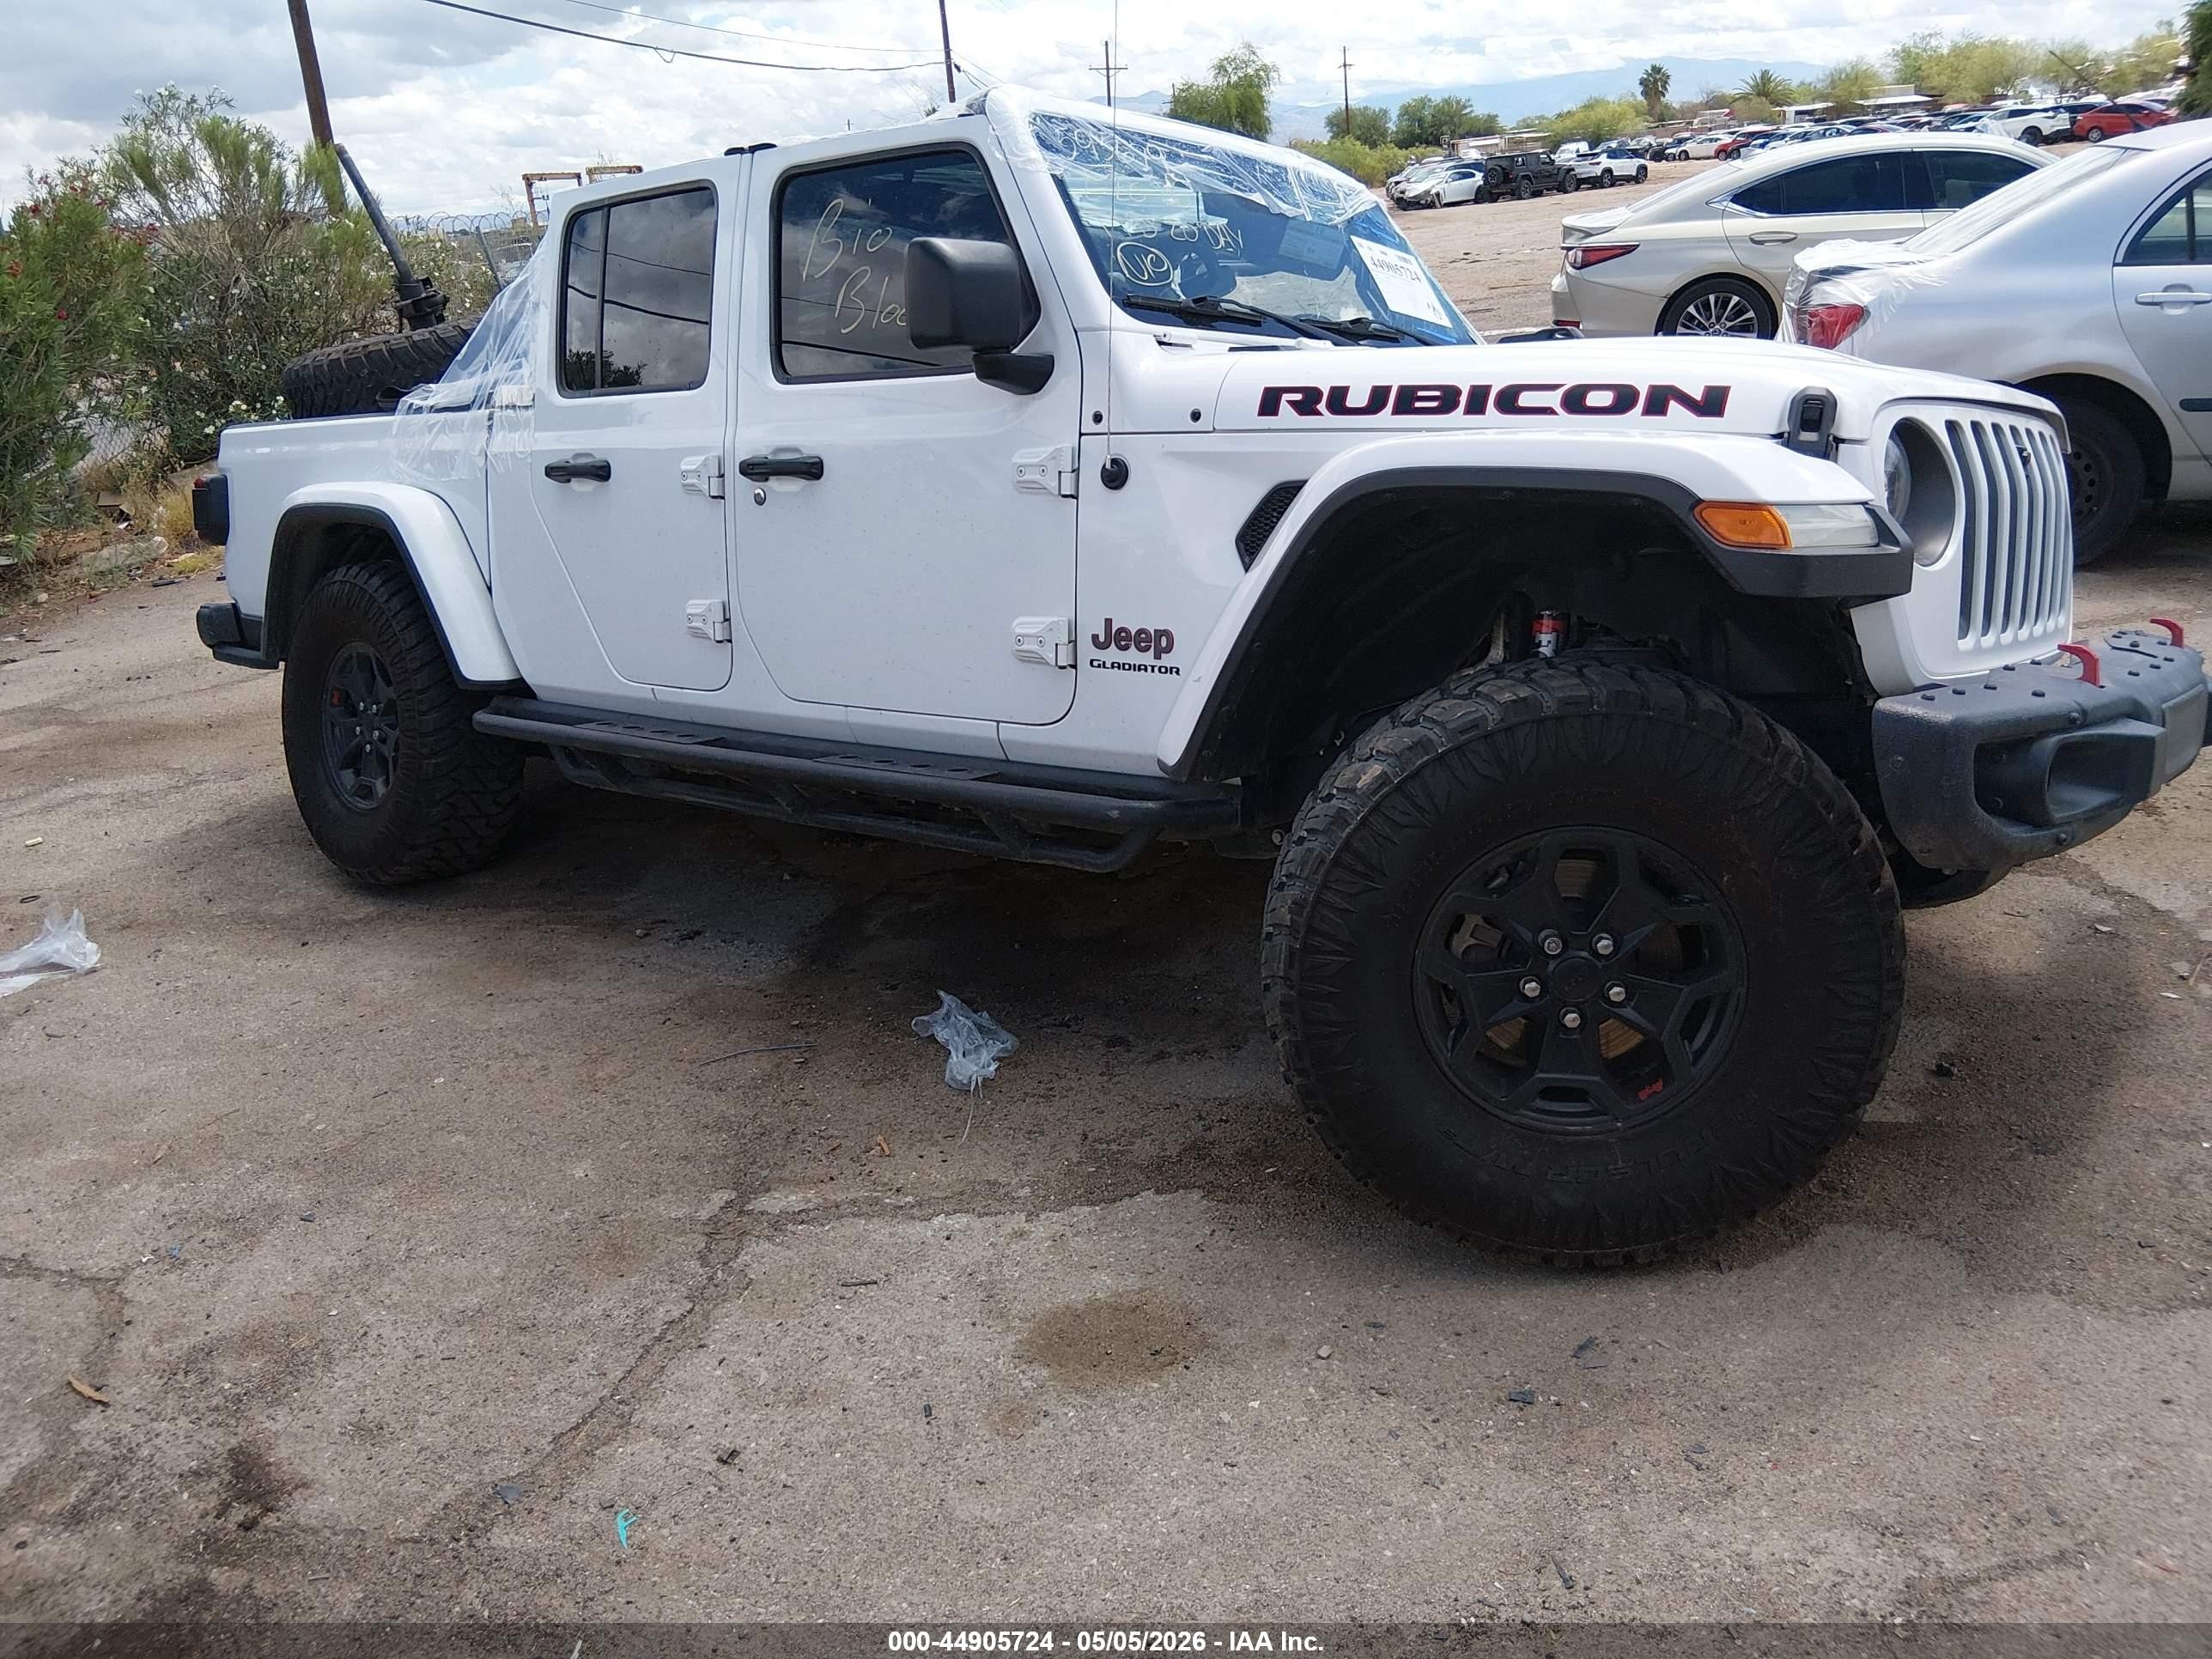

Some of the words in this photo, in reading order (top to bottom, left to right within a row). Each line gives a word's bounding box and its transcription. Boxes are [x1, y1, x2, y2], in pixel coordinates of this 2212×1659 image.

[1370, 255, 1422, 283] 44905724
[1257, 383, 1732, 417] RUBICON
[1091, 617, 1175, 660] Jeep
[1089, 658, 1182, 677] GLADIATOR
